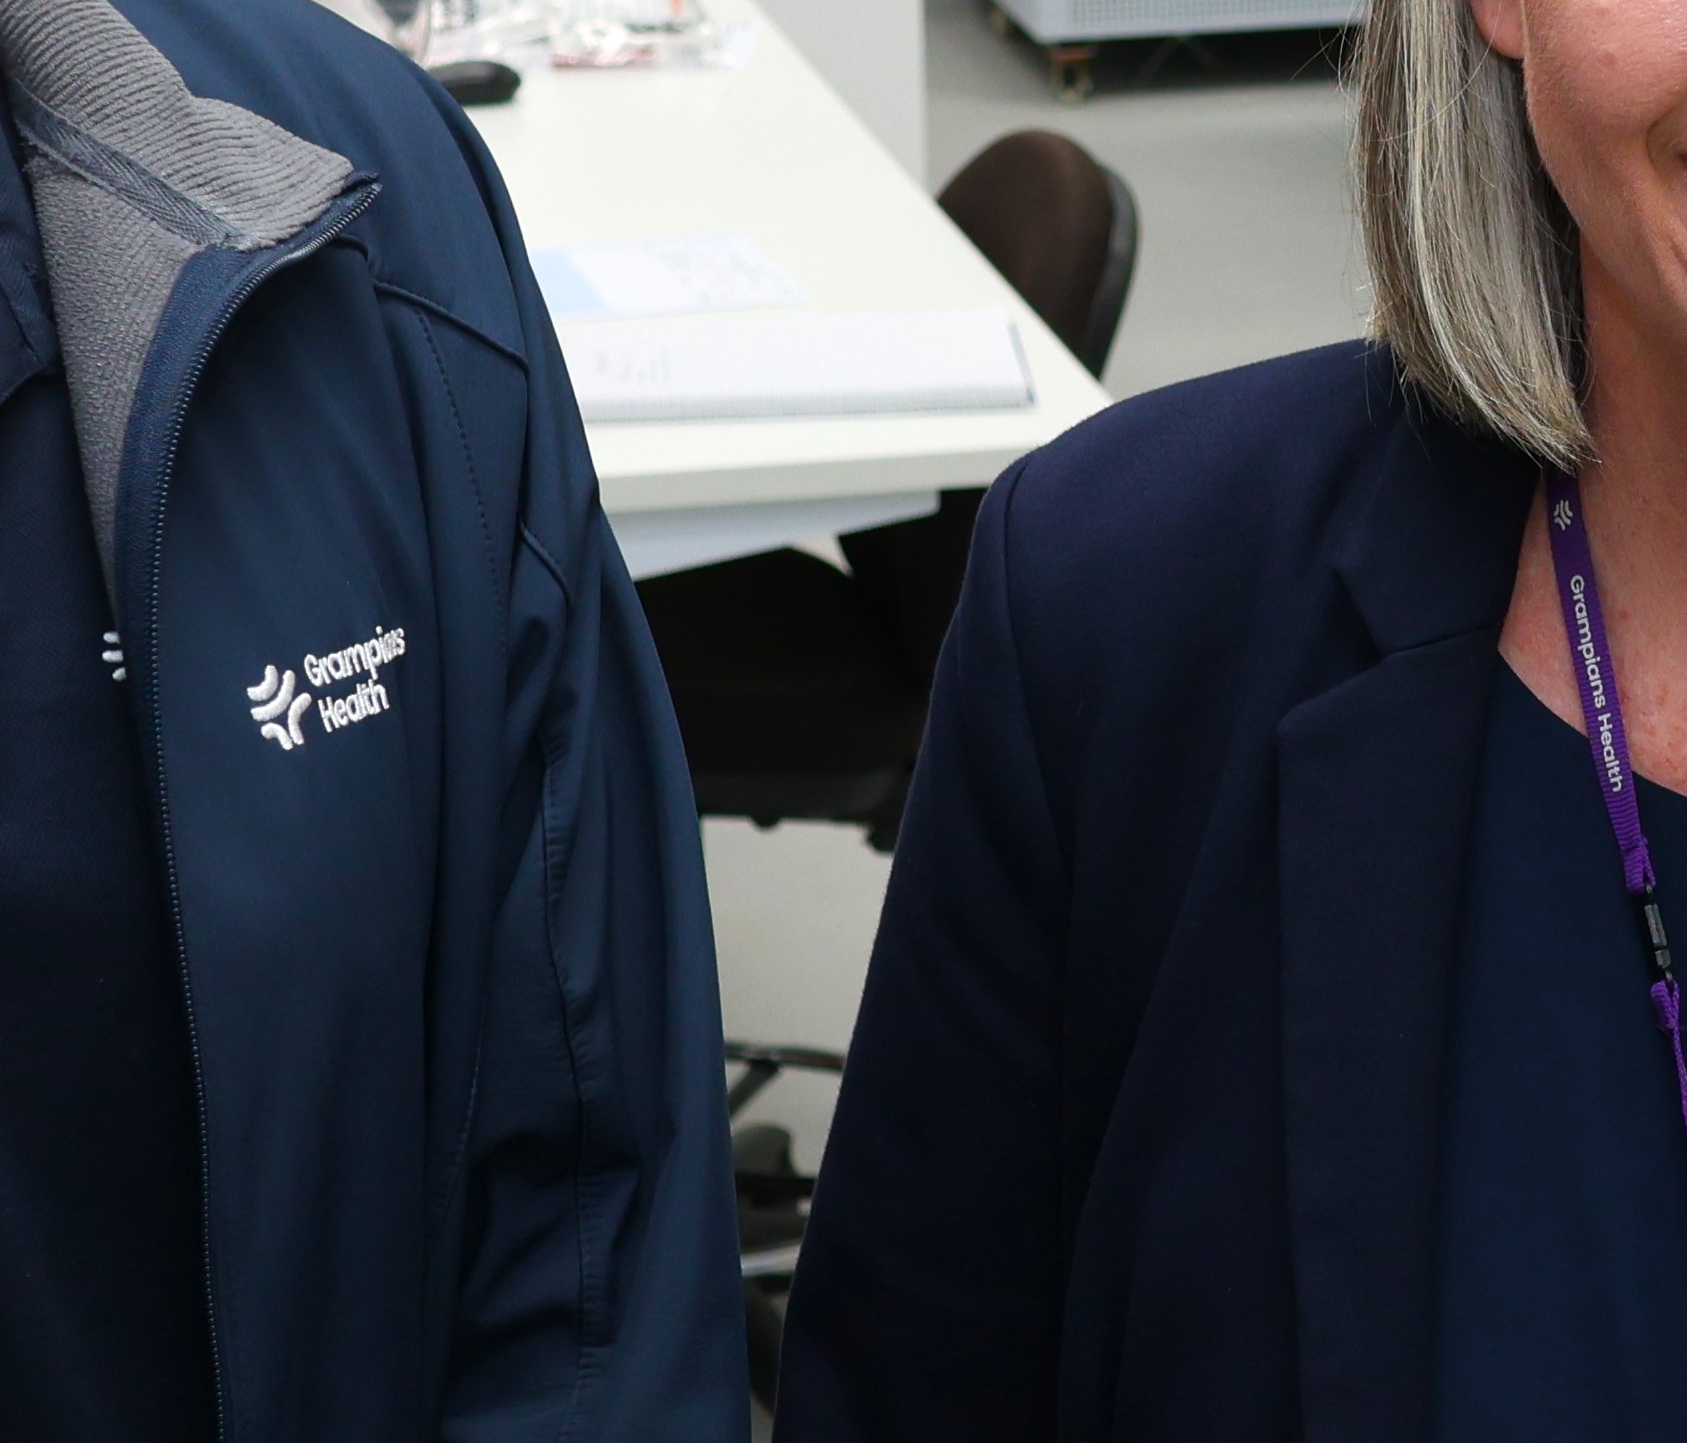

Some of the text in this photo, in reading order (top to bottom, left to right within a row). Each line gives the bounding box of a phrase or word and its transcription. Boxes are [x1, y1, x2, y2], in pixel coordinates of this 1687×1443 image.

[317, 678, 390, 734] Health
[1570, 574, 1624, 793] Grampians Health
